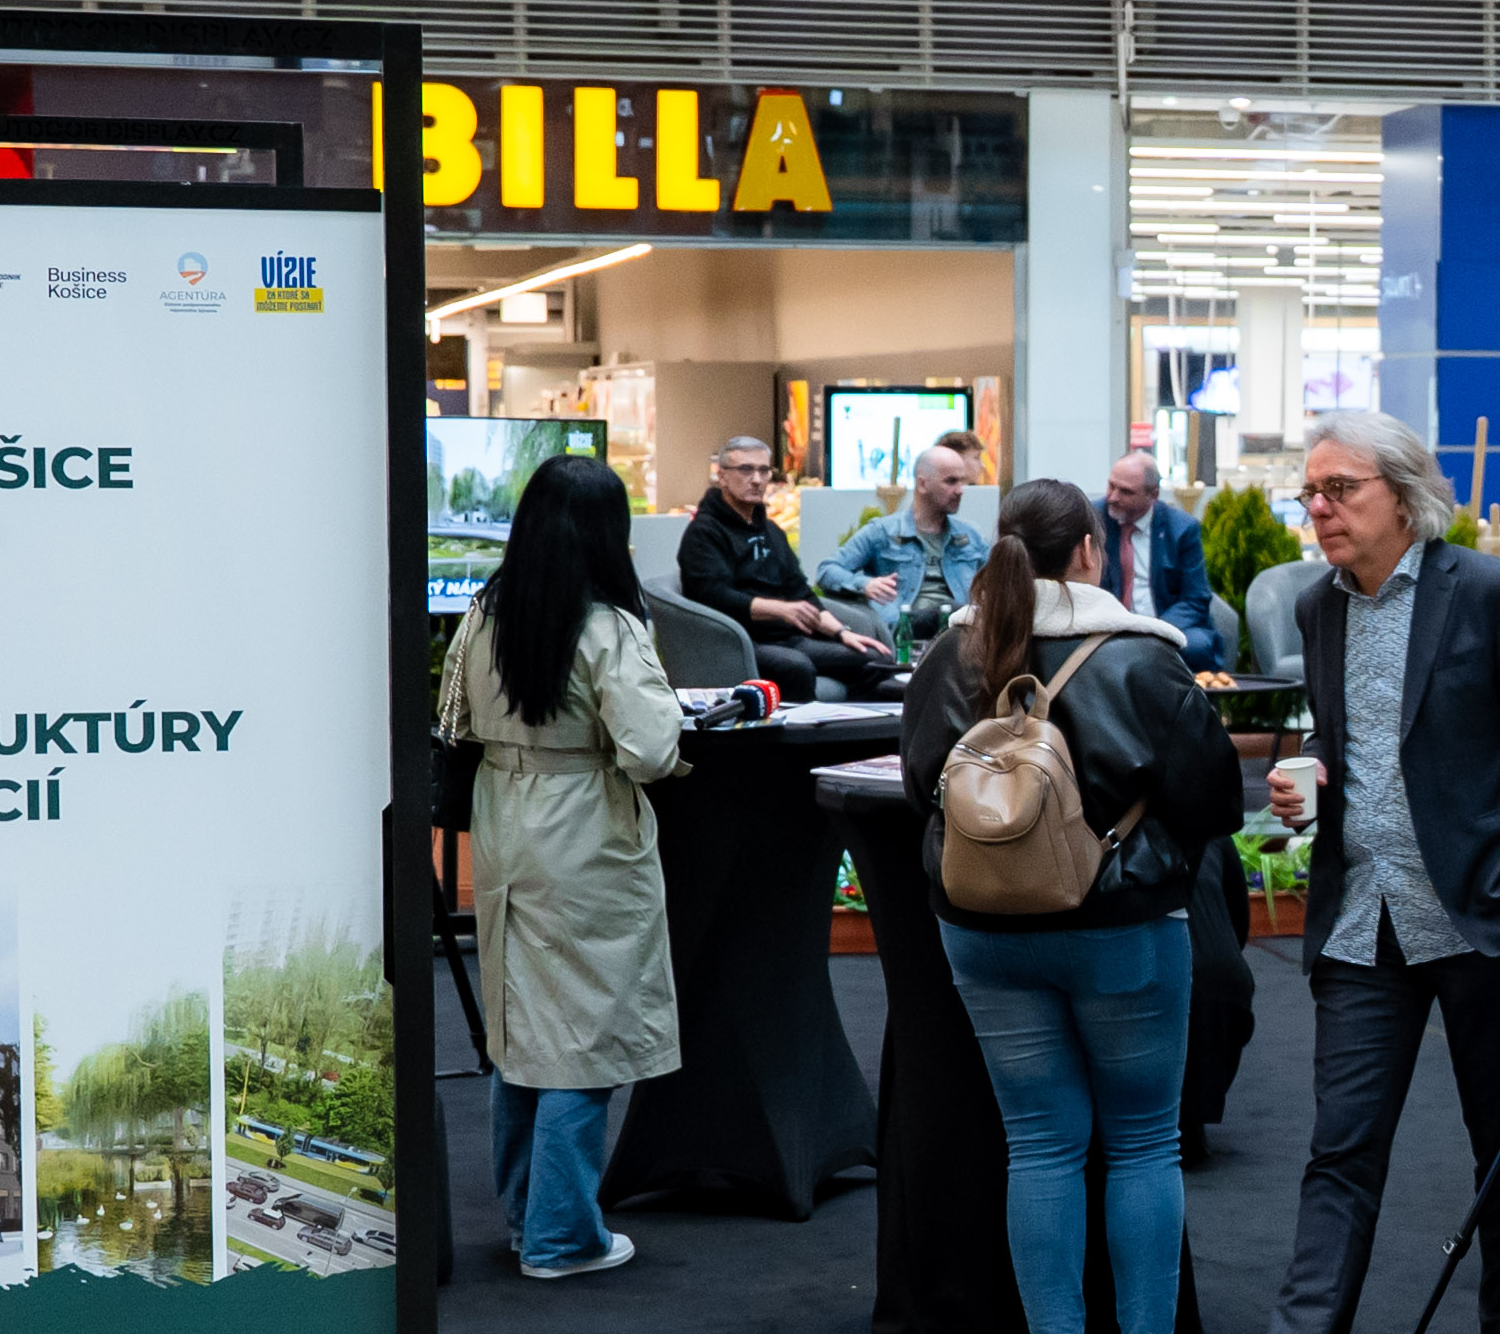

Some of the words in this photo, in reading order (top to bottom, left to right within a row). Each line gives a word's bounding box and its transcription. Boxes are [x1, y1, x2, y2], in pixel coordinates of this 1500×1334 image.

[373, 80, 833, 213] BILLA
[47, 266, 128, 284] Business
[261, 251, 318, 289] VÍZIE
[47, 283, 108, 299] Košice
